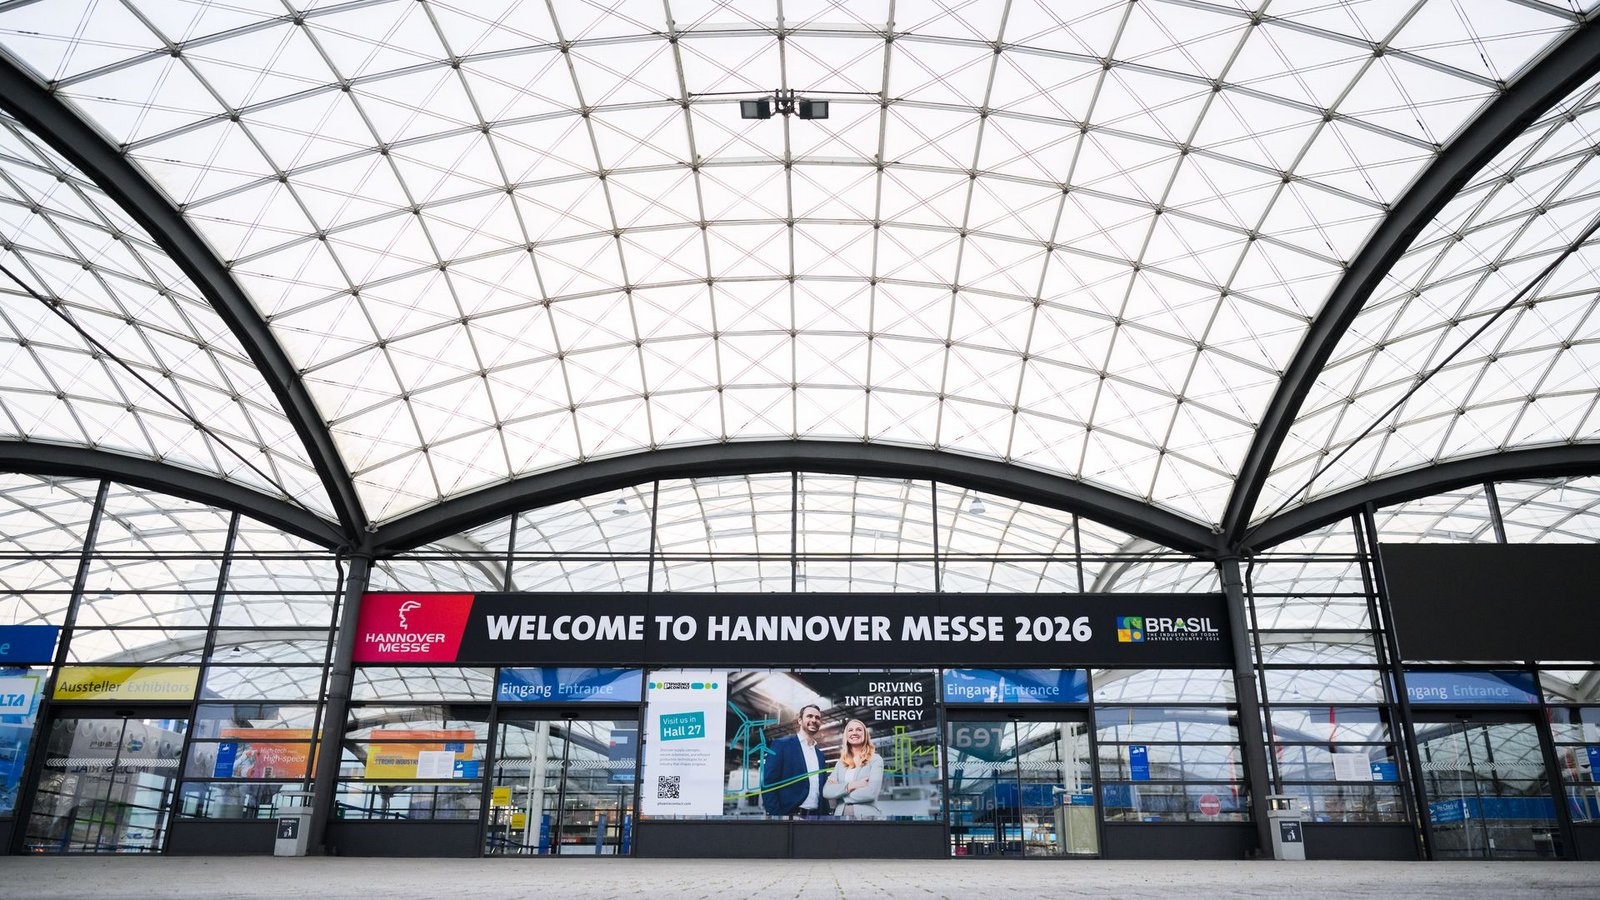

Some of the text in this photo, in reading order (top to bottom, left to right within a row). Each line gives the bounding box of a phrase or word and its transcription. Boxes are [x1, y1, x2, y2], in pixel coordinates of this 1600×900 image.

[486, 615, 1092, 642] WELCOME TO HANNOVER MESSE 2026
[1145, 617, 1219, 632] BRASIL
[365, 633, 445, 643] HANNOVER
[378, 643, 430, 652] MESSE
[58, 681, 190, 693] Aussteller Exhibitors
[501, 682, 613, 698] Eingang Entrance
[869, 682, 923, 693] DRIVING
[947, 684, 1060, 698] Eingang Entrance
[1406, 685, 1509, 700] ngang Entrance
[845, 696, 923, 707] INTEGRATED
[662, 717, 678, 725] Visit
[874, 710, 924, 721] ENERGY
[663, 725, 701, 737] Hall 27
[263, 753, 305, 764] High-speed
